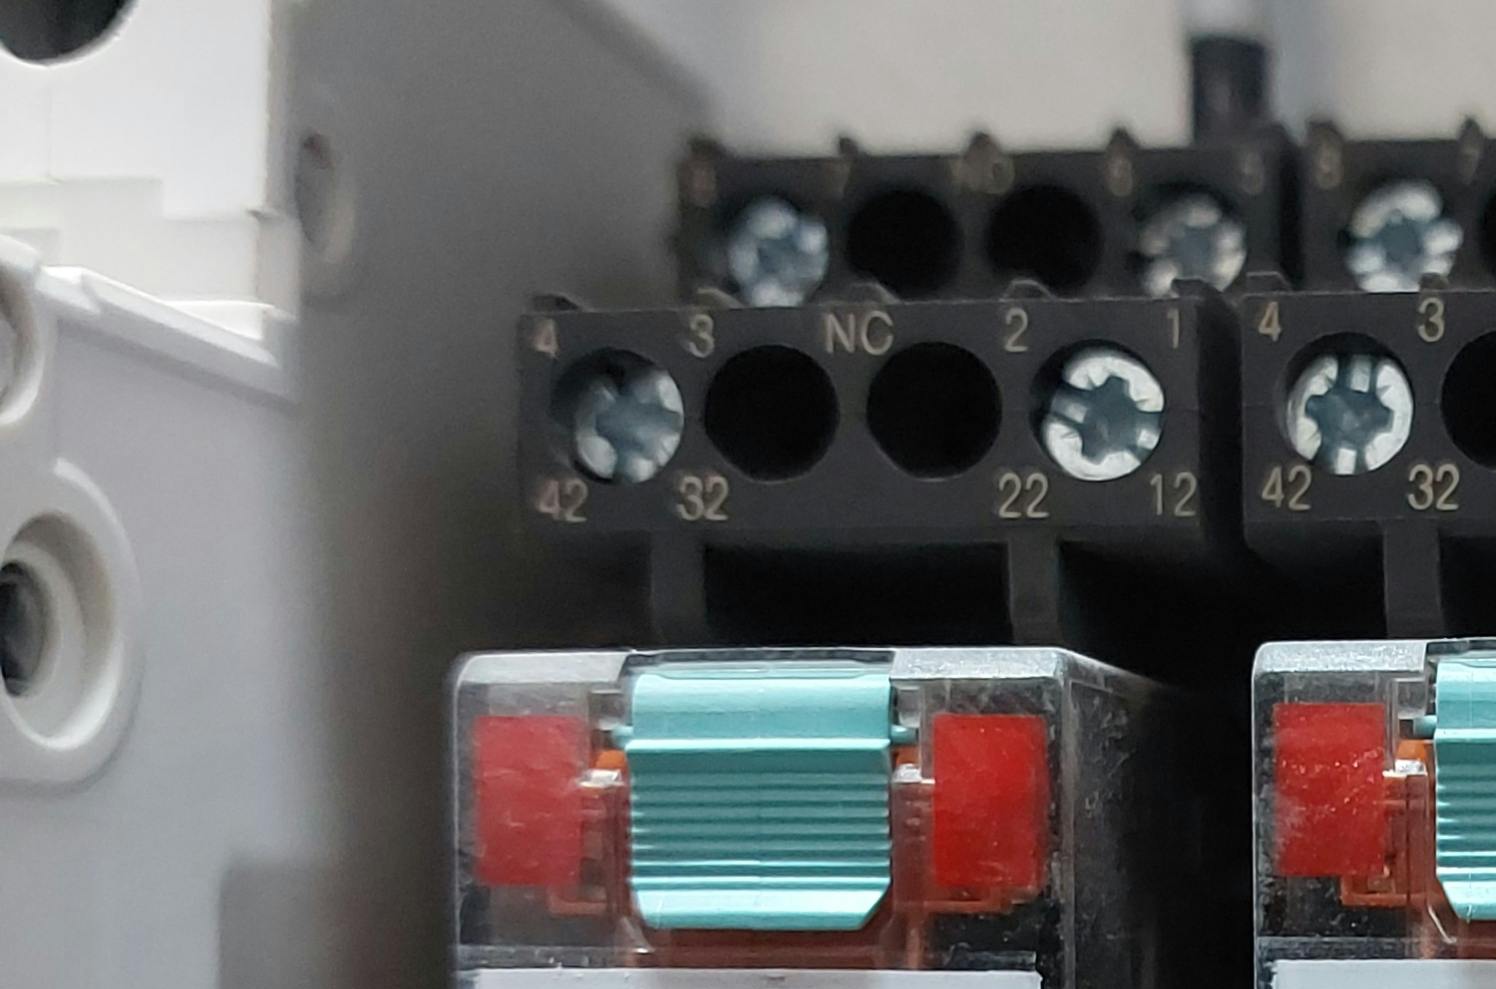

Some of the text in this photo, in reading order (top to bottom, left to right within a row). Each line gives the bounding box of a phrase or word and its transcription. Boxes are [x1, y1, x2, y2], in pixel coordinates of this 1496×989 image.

[535, 308, 1180, 358] 4 3 NC 2 1
[1257, 302, 1282, 341] 4
[1418, 299, 1445, 342] 3
[538, 473, 1197, 522] 42 32 22 12
[1261, 467, 1312, 510] 42
[1408, 465, 1460, 510] 32
